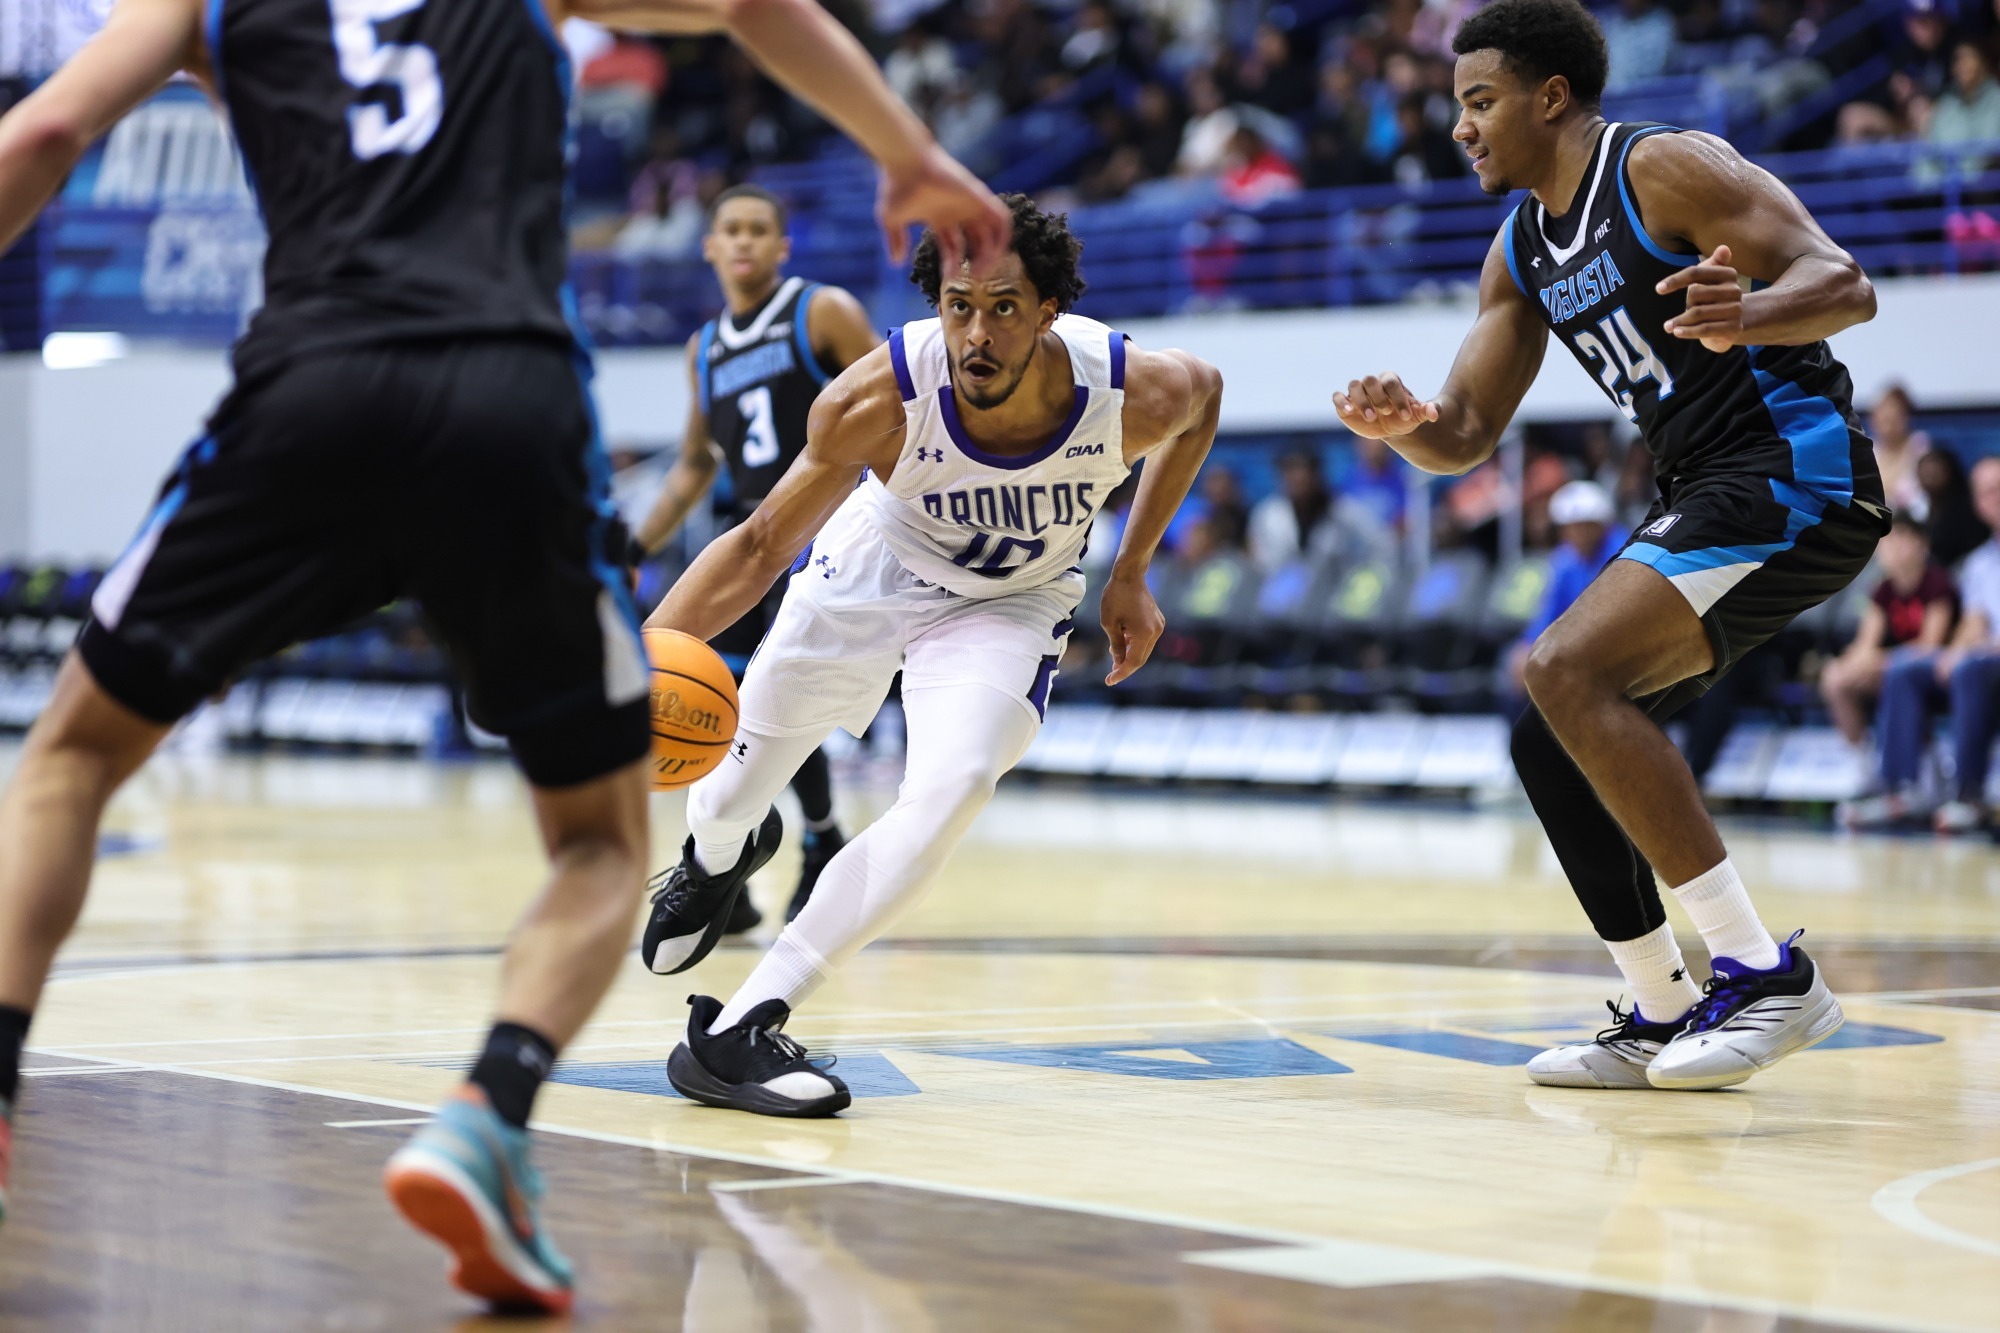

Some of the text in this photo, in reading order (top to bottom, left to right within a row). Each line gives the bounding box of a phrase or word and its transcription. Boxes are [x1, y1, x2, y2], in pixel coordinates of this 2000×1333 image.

[327, 0, 445, 162] 5
[1593, 217, 1612, 244] PBC
[1572, 304, 1676, 422] 24
[736, 385, 780, 468] 3
[1065, 443, 1104, 459] CIAA
[922, 482, 1094, 536] BRONCOS
[951, 530, 1046, 578] 10
[648, 685, 721, 735] ilson
